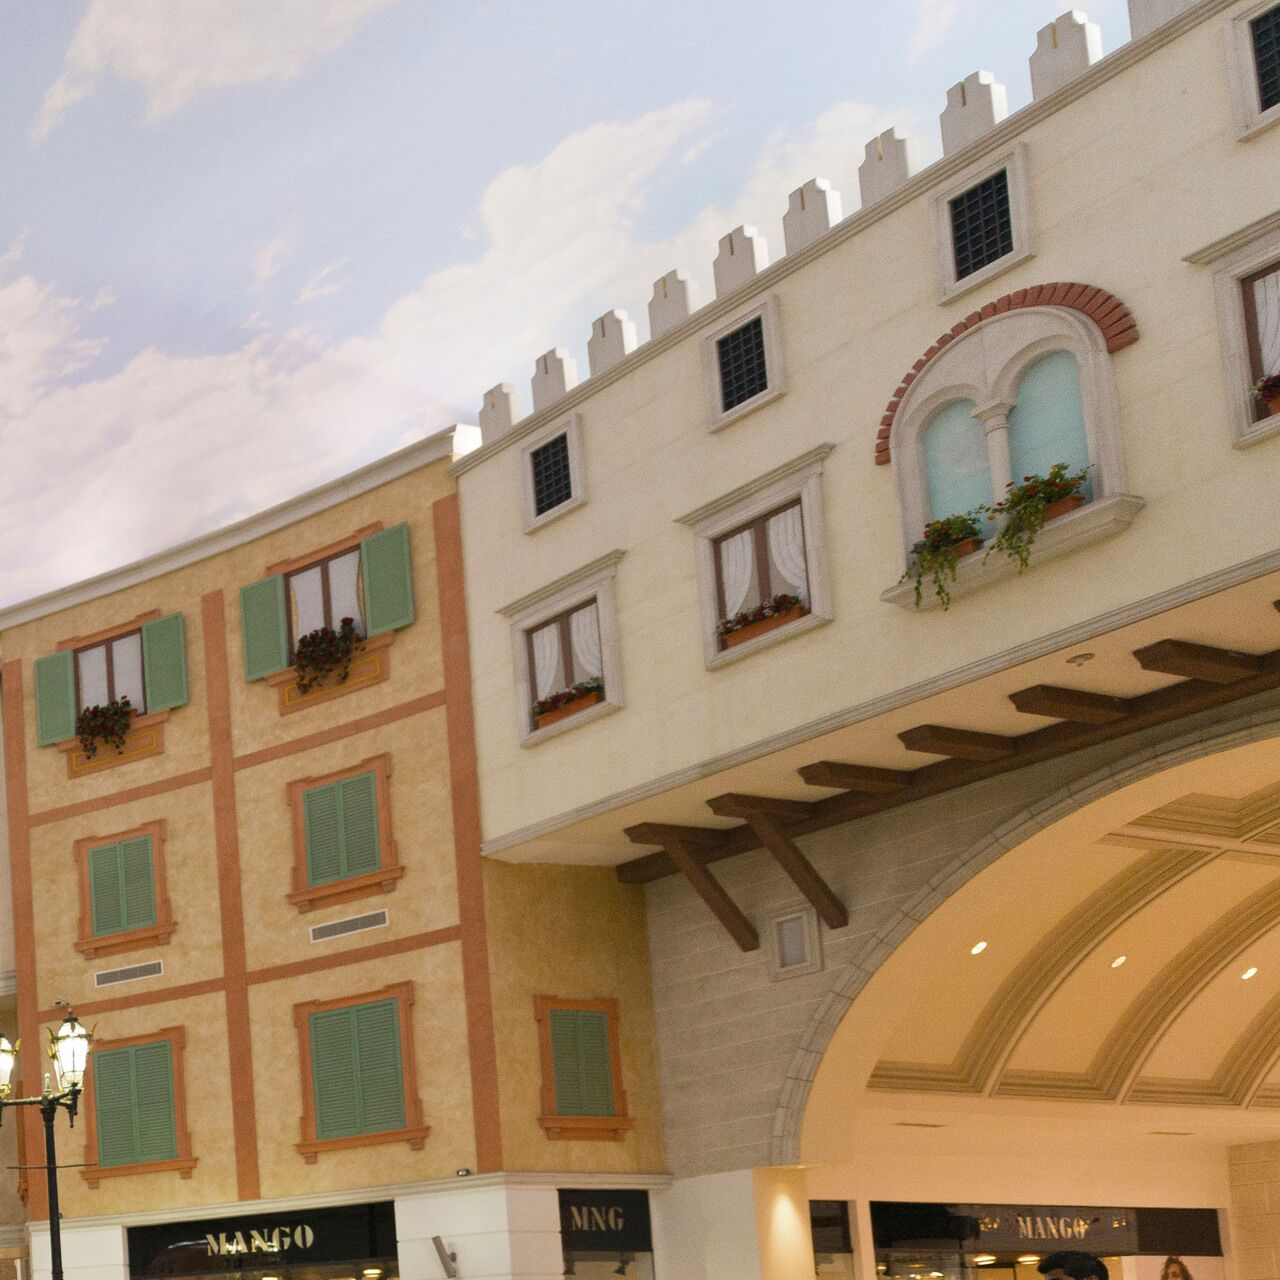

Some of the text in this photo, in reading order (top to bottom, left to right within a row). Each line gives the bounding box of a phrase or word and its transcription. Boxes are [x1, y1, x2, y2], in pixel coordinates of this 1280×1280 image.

[570, 1206, 625, 1231] MNG
[1017, 1216, 1088, 1239] MANGO
[206, 1224, 314, 1256] MANGO
